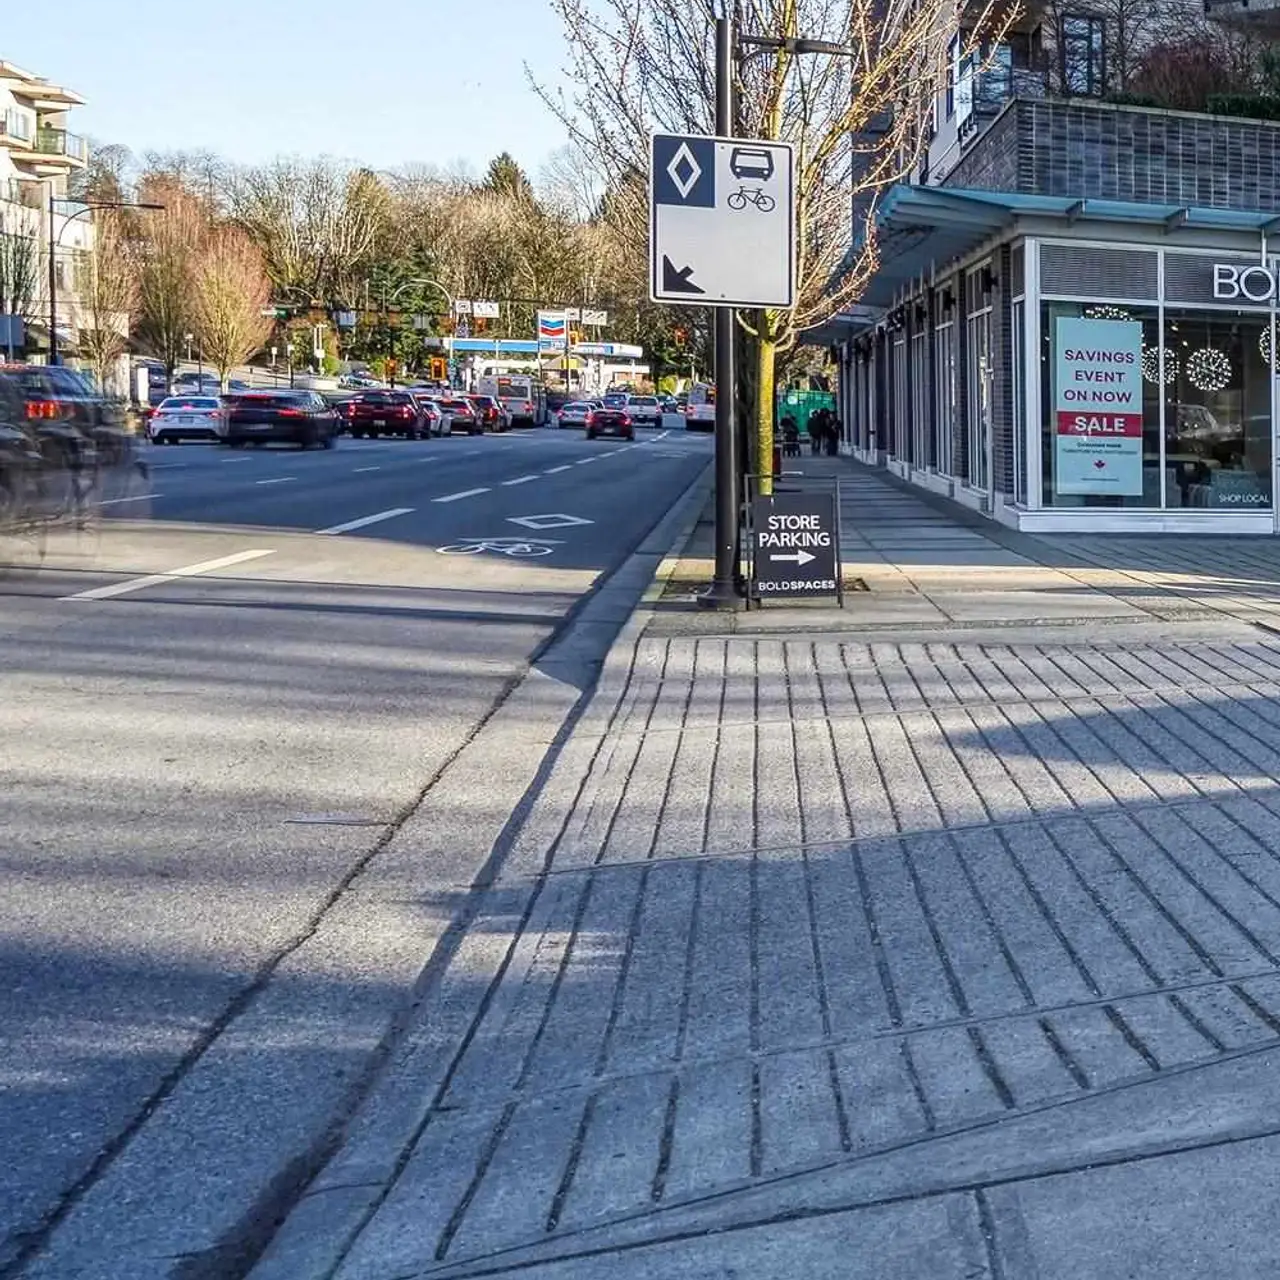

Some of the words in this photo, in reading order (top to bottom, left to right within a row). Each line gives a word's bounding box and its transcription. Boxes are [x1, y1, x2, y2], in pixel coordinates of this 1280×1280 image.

[1065, 349, 1135, 364] SAVINGS
[1075, 370, 1126, 384] EVENT
[1064, 389, 1087, 402] ON
[1092, 391, 1132, 403] NOW
[1074, 416, 1126, 433] SALE
[1242, 493, 1270, 503] LOCAL
[768, 515, 820, 530] STORE
[759, 532, 831, 548] PARKING
[758, 580, 836, 592] BOLDSPACES
